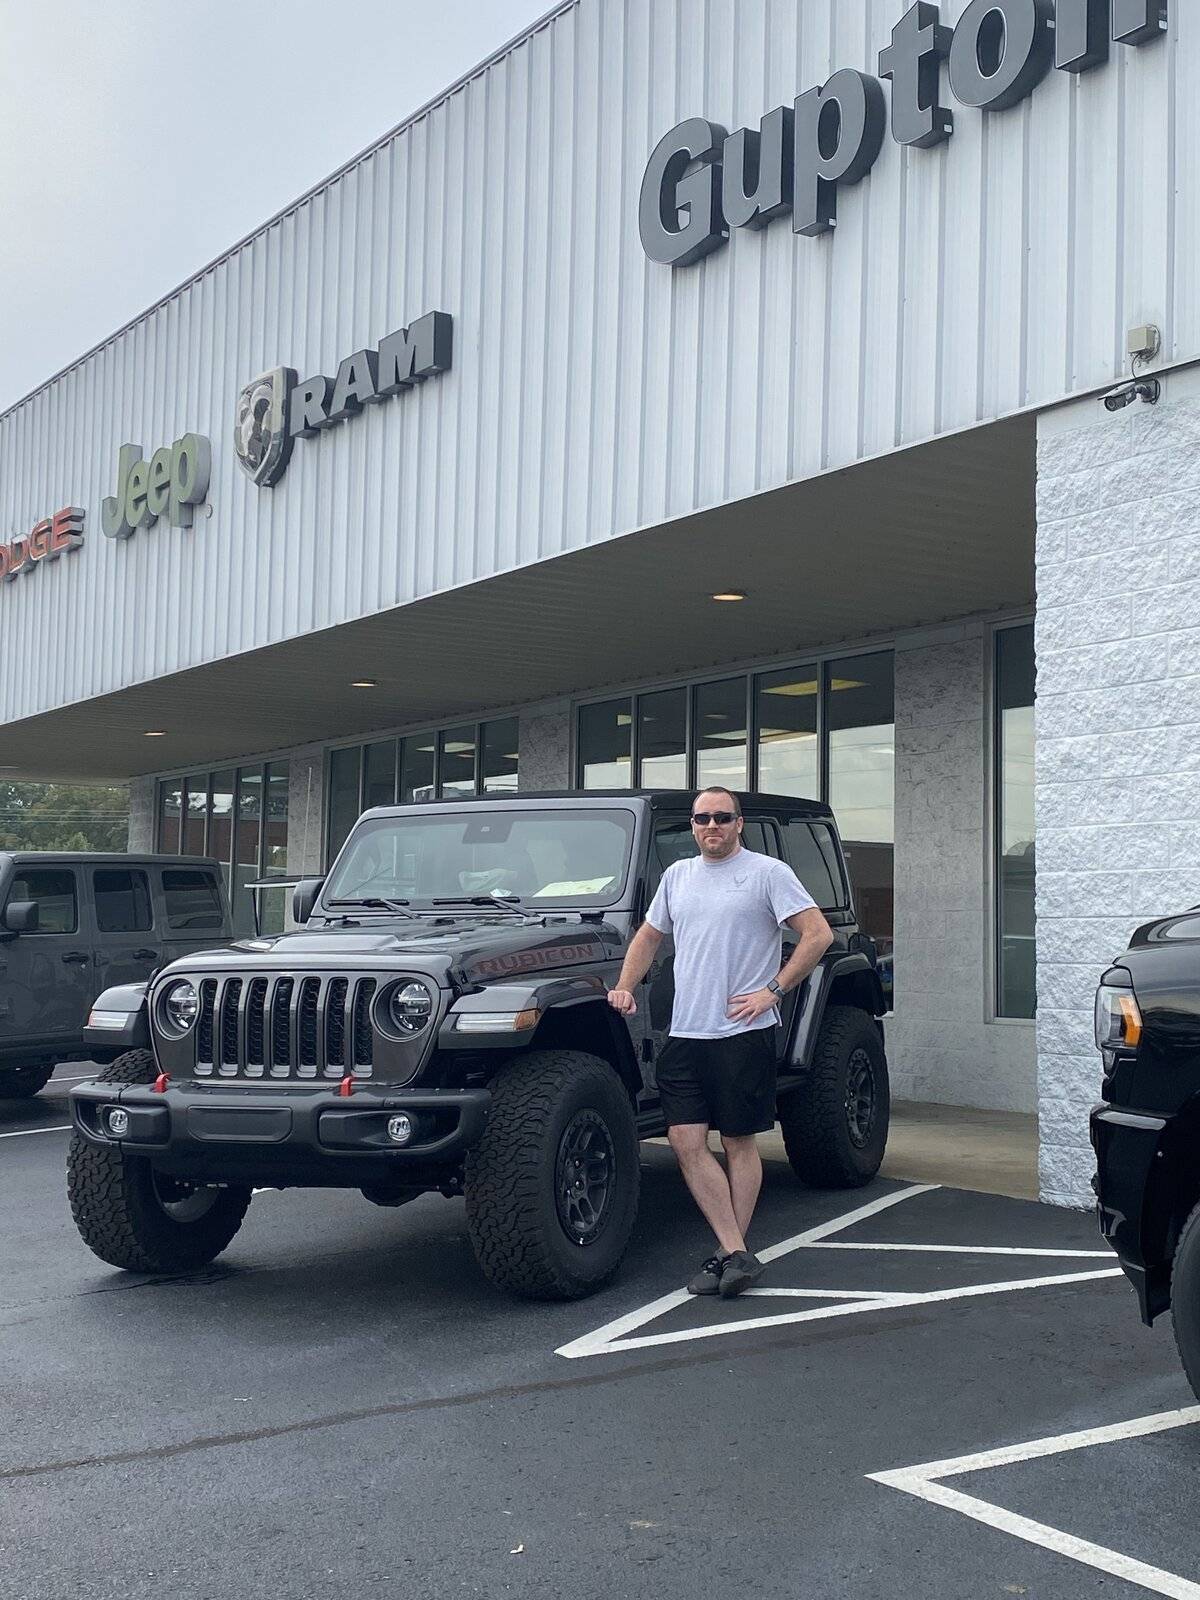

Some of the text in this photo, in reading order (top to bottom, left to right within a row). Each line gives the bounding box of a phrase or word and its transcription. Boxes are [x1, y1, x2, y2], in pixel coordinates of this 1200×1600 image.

[290, 311, 452, 438] RAM
[101, 433, 211, 540] Jeep
[477, 944, 594, 973] RUBICON
